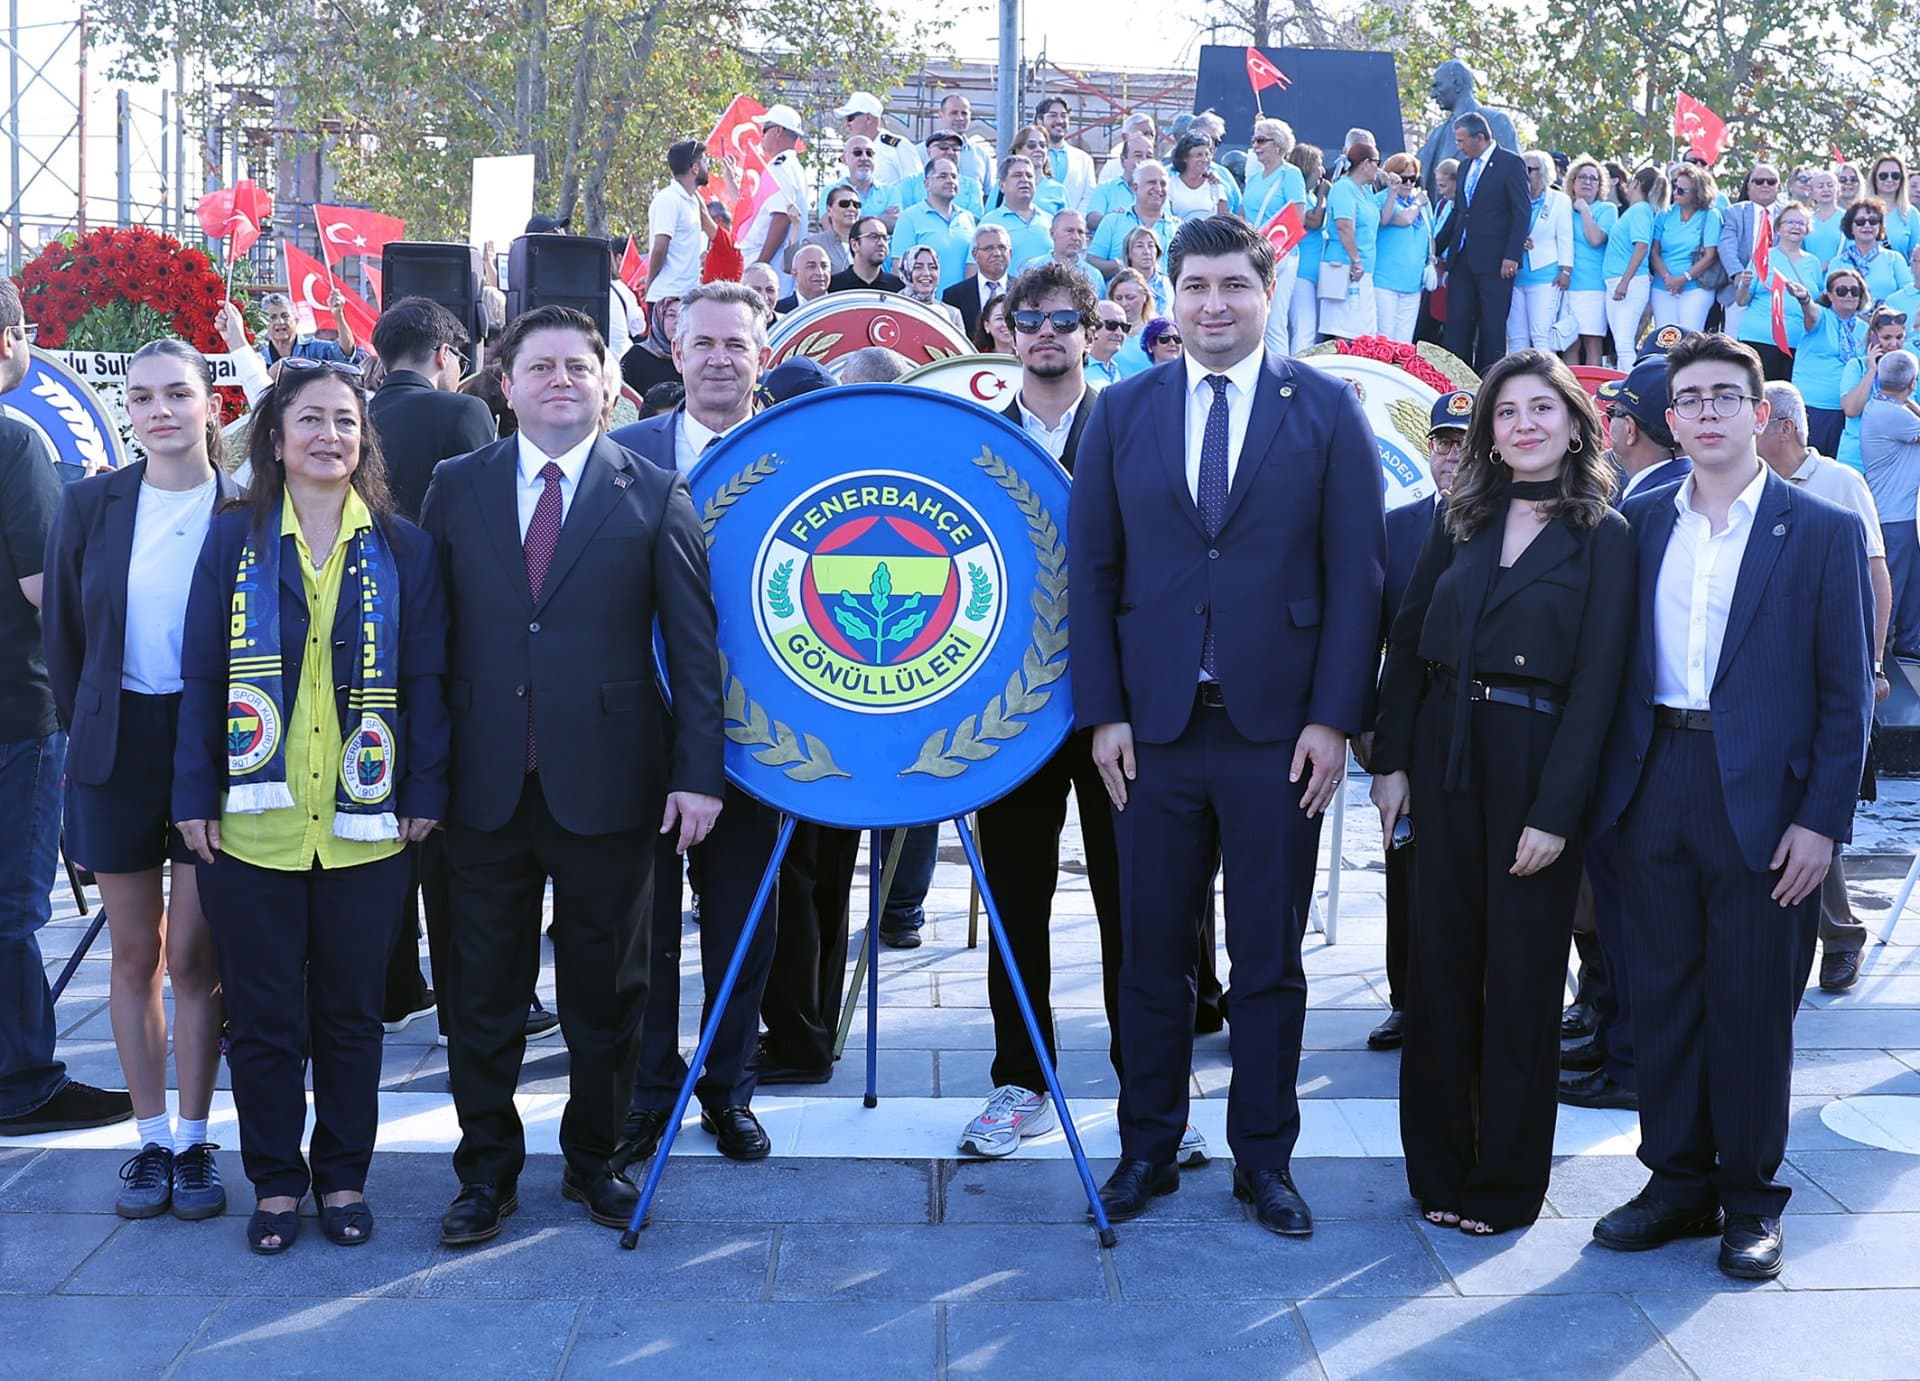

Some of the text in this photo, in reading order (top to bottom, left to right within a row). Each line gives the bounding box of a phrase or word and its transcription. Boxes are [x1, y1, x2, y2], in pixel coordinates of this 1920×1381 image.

[790, 486, 974, 545] FENERBAHÇE
[787, 632, 972, 696] GÖNÜLLÜLERİ
[232, 690, 262, 707] SPOR
[230, 757, 249, 768] 907
